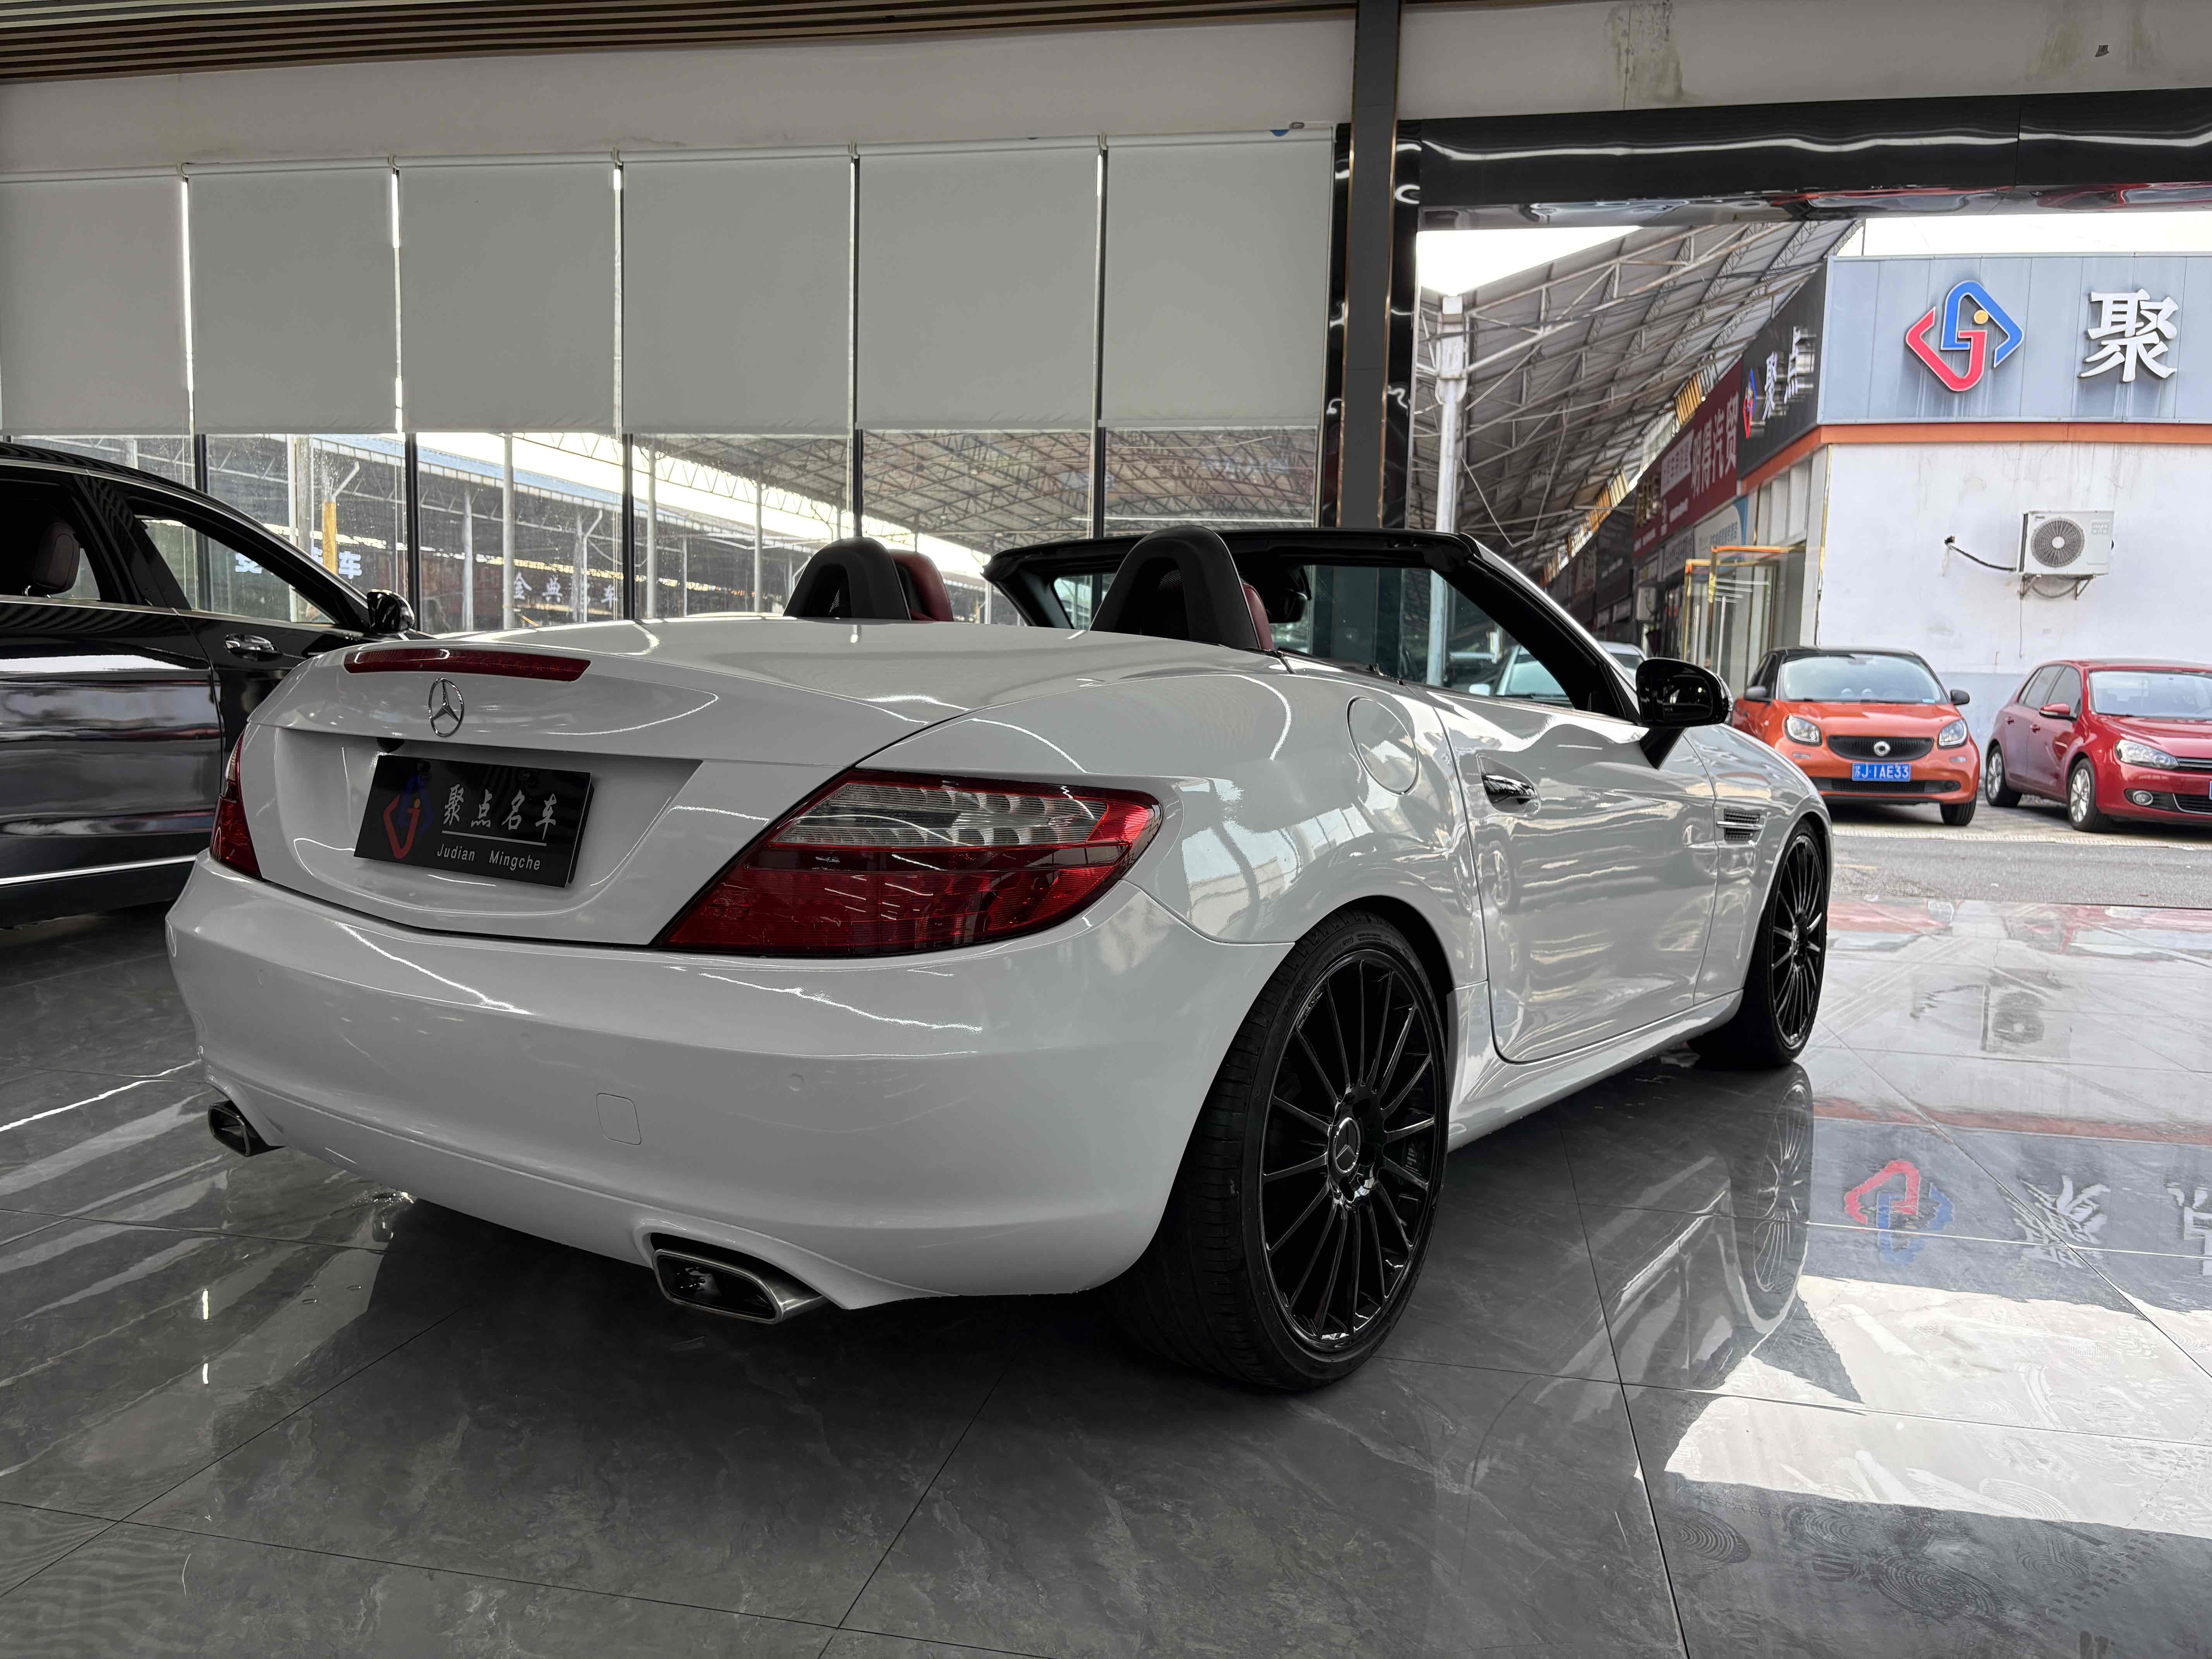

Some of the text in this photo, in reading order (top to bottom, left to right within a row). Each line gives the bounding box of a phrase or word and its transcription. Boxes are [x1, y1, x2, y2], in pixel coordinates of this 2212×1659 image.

[2078, 288, 2179, 383] 聚
[443, 784, 557, 840] 聚点名车
[437, 843, 541, 871] Judian Mingche
